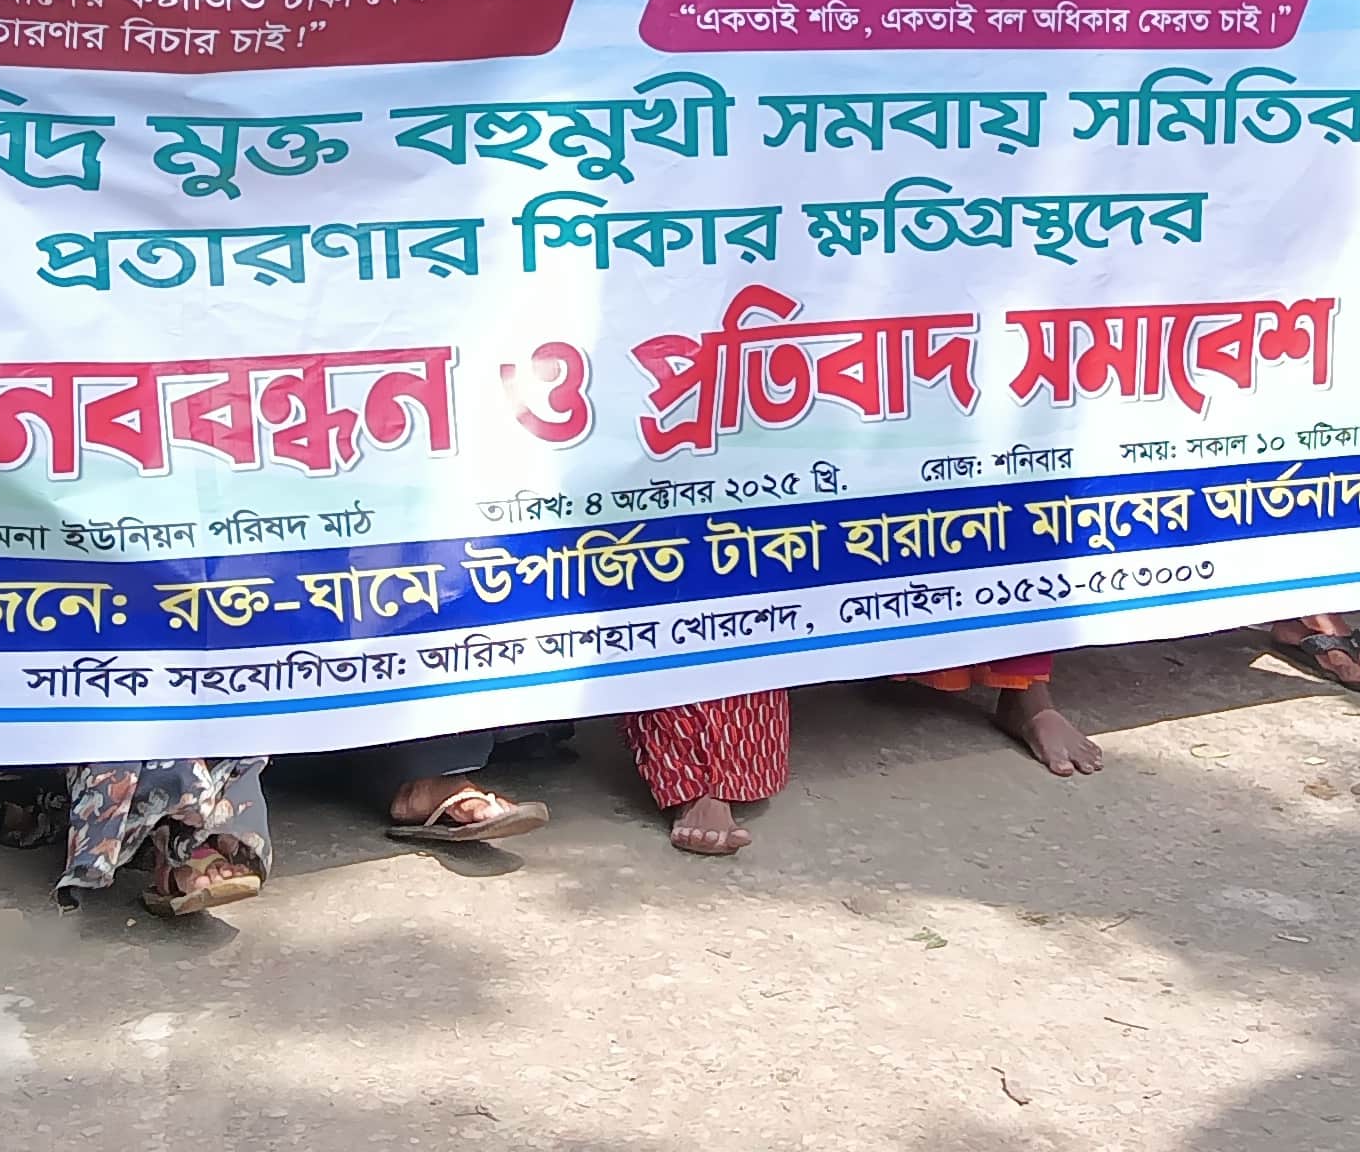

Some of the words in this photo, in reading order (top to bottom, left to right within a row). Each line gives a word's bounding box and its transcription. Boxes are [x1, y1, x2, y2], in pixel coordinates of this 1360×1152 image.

[122, 17, 220, 55] বিচার
[679, 3, 798, 34] “একতাই
[881, 4, 976, 34] একতাই
[987, 8, 1025, 34] বল
[1034, 1, 1128, 34] অধিকার
[1138, 7, 1212, 34] ফেরত
[146, 112, 362, 199] মুক্ত
[395, 71, 735, 185] বহুমুখী
[759, 90, 1047, 156] সমবায়
[37, 214, 485, 292] প্রতারণার
[514, 189, 782, 274] শিকার
[803, 176, 1209, 267] ক্ষতিগ্রস্থদের
[498, 340, 597, 450] ও
[630, 283, 982, 460] প্রতিবাদ
[1004, 294, 1342, 418] সমাবেশ
[920, 456, 984, 486] রোজ:
[993, 443, 1074, 477] শনিবার
[1120, 438, 1180, 465] সময়:
[1187, 433, 1245, 459] সকাল
[1252, 435, 1287, 456] ১০
[1297, 422, 1360, 452] ঘটিকা
[477, 492, 574, 525] তারিখ:
[584, 490, 603, 519] ৪
[612, 476, 715, 513] অক্টোবর
[724, 471, 800, 504] ২০২৫
[60, 518, 196, 554] ইউনিয়ন
[209, 509, 308, 548] পরিষদ
[320, 501, 375, 540] মাঠ
[155, 564, 444, 635] রক্ত-ঘামে
[462, 518, 690, 610] উপার্জিত
[704, 516, 826, 581] টাকা
[844, 500, 1012, 568] হারানো
[1029, 489, 1186, 562] মানুষের
[22, 656, 149, 701] সার্বিক
[417, 633, 525, 674] আরিফ
[536, 619, 658, 663] আশহাব
[838, 585, 964, 626] মোবাইল:
[972, 558, 1216, 607] ০১৫২১-৫৫৩০০৩
